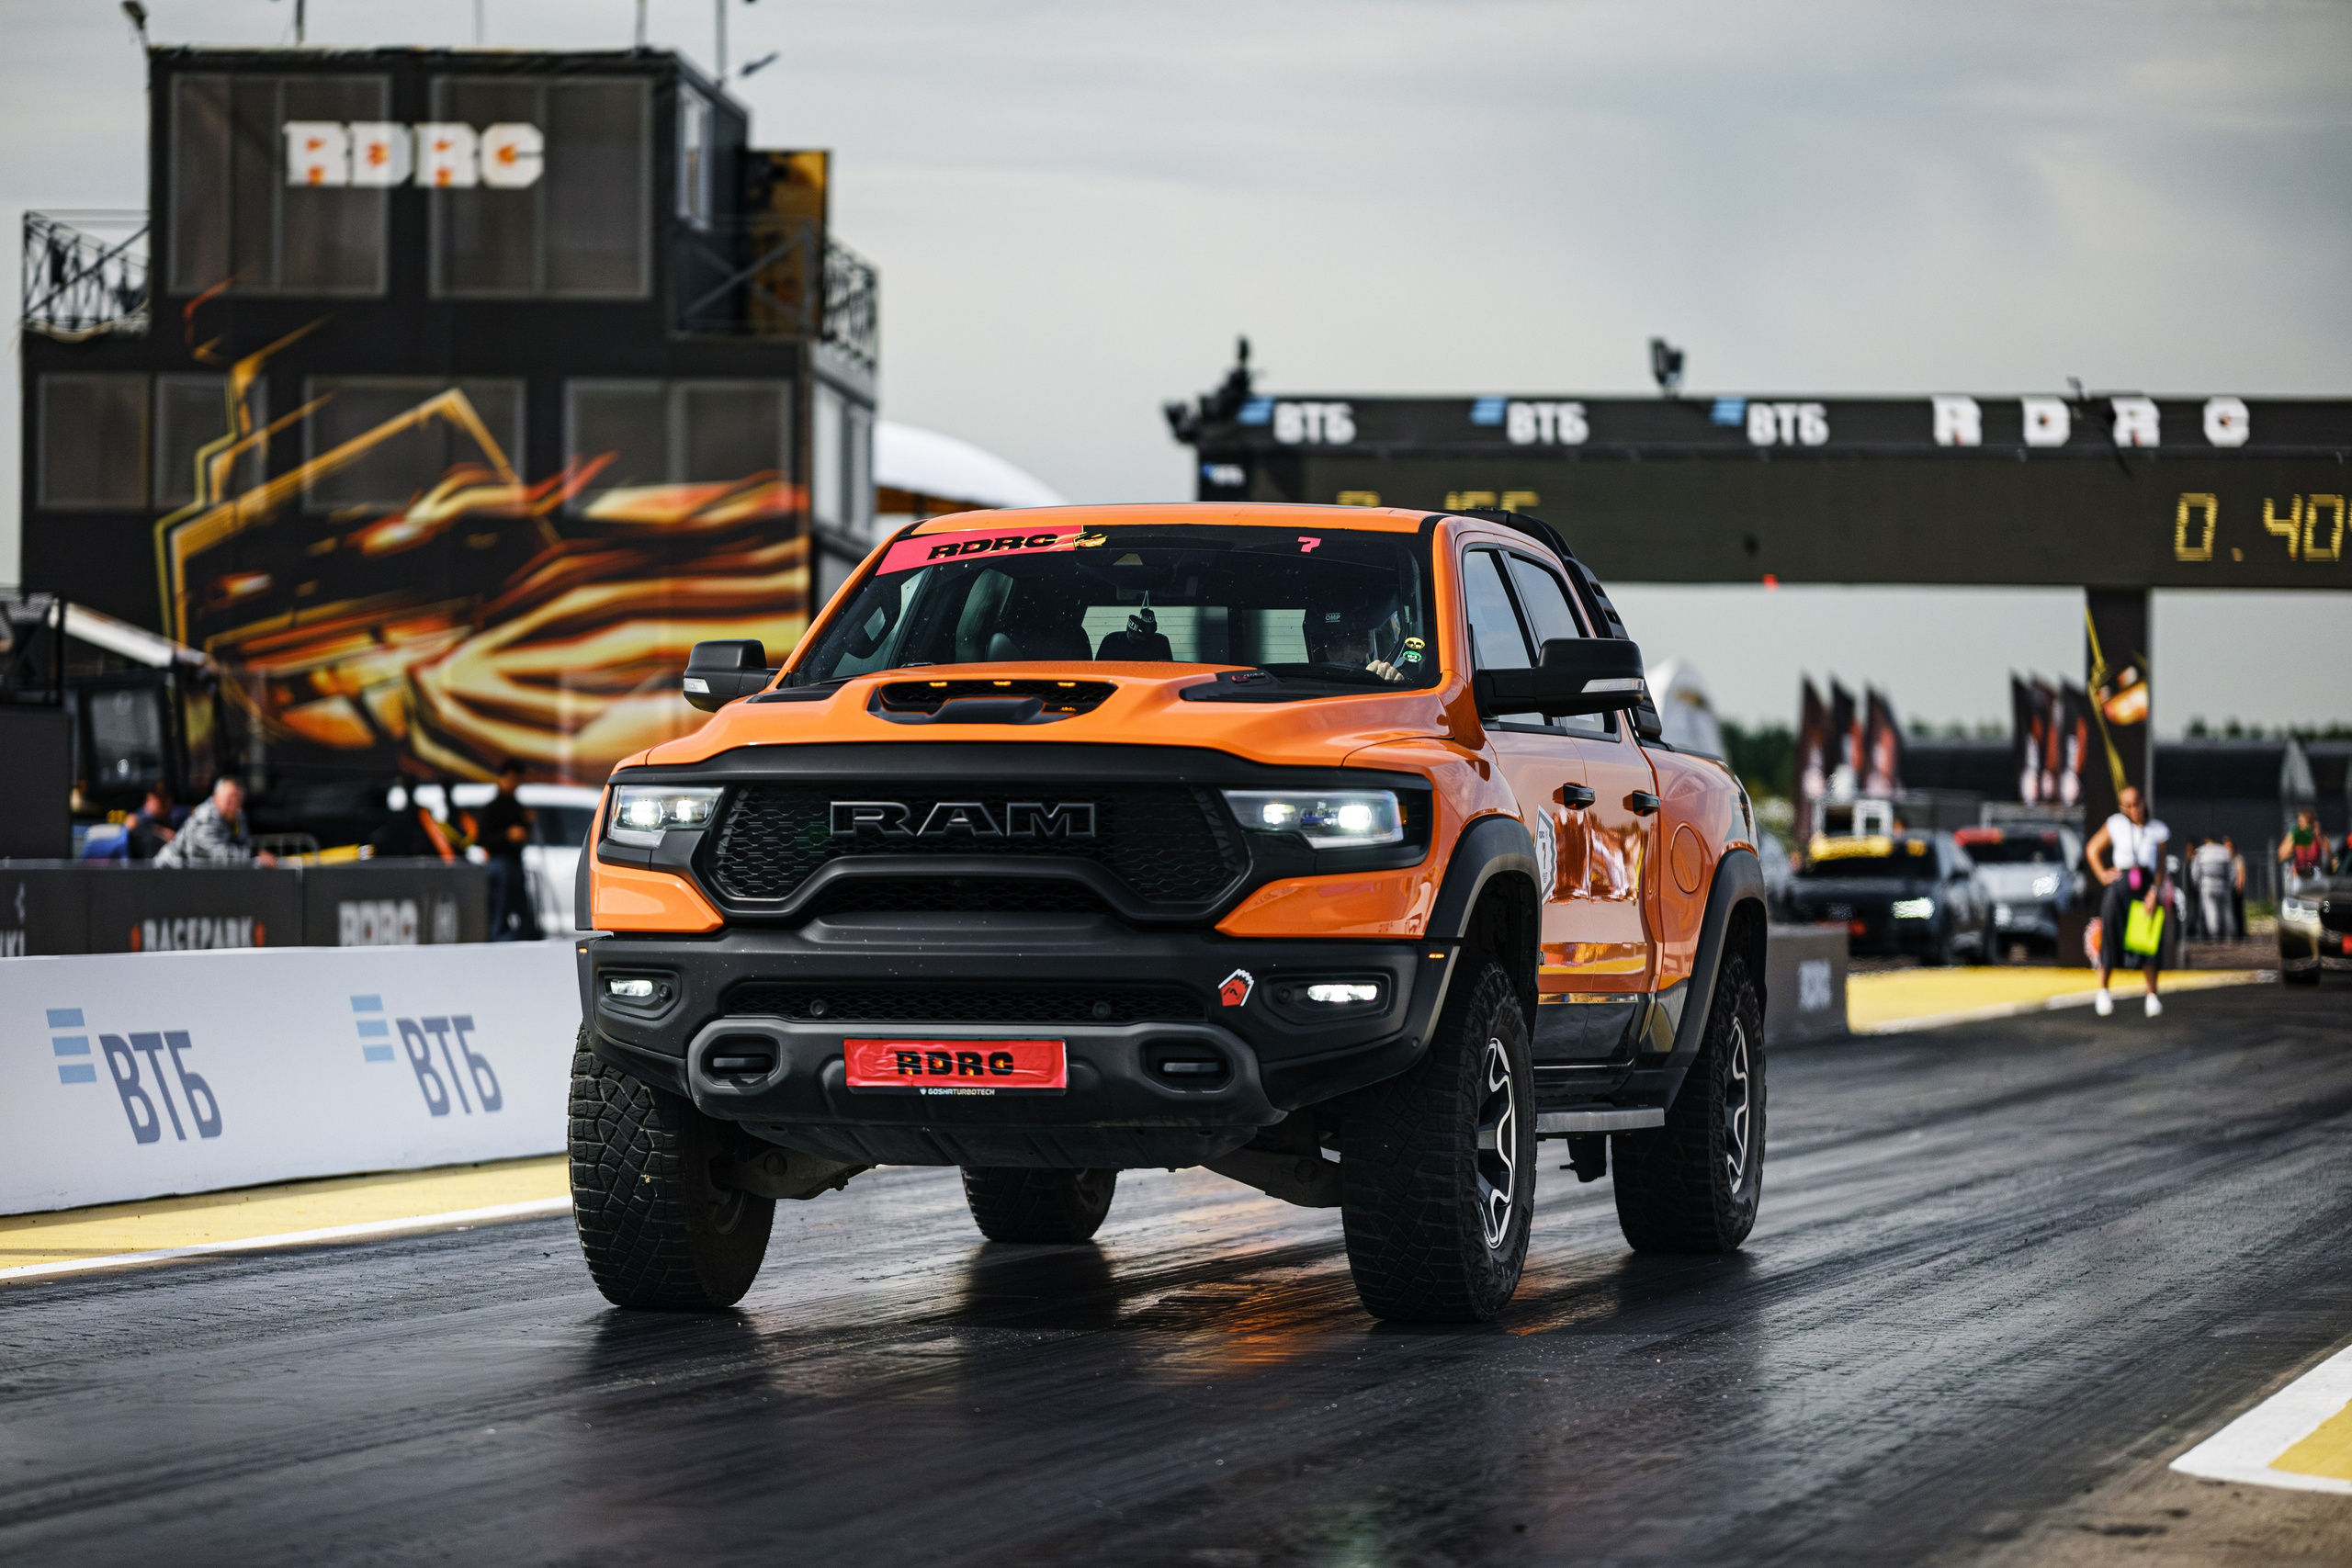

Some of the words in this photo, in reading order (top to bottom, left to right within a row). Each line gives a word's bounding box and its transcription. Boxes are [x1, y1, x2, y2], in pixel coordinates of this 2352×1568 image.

[283, 120, 544, 187] RDRC
[1273, 403, 1356, 446] ВТБ
[1507, 403, 1589, 446] ВТБ
[1747, 402, 1829, 446] ВТБ
[927, 534, 1058, 560] RDRC
[1297, 536, 1322, 553] 7
[2174, 493, 2352, 561] 0.40
[830, 801, 1096, 837] RAM
[395, 1014, 503, 1117] ВТБ
[895, 1051, 1013, 1076] RDRC
[98, 1029, 222, 1145] ВТБ
